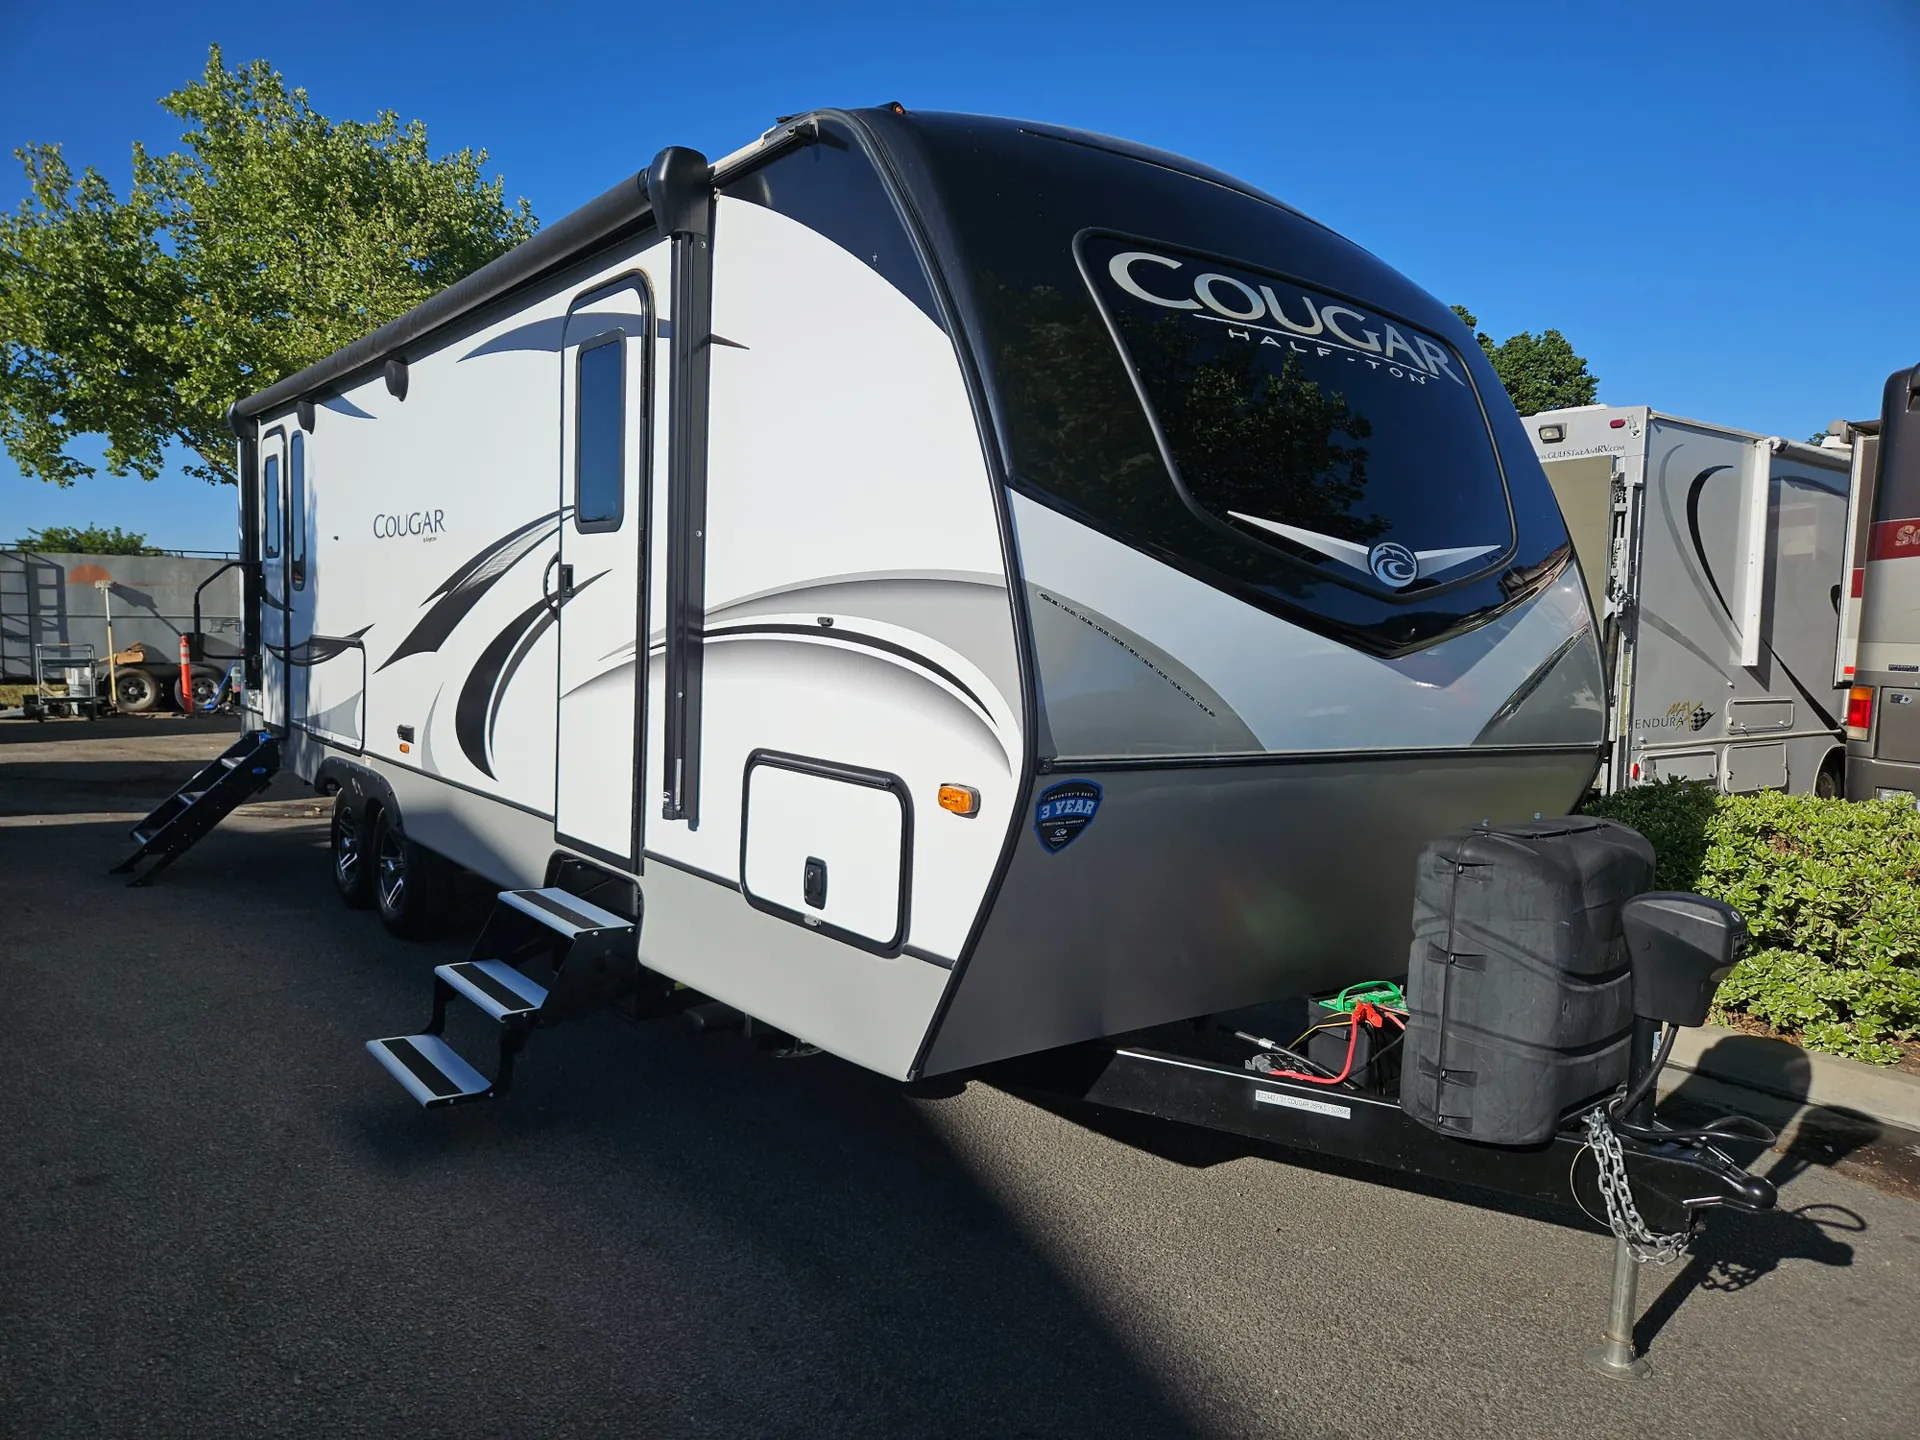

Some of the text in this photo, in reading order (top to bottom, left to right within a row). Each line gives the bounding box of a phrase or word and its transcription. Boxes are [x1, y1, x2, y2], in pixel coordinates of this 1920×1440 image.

[1108, 251, 1466, 388] COUGAR
[1227, 327, 1427, 386] HALF-TON
[373, 508, 447, 539] COUGAR
[1635, 715, 1684, 729] ENDURA
[1040, 799, 1095, 819] 3 YEAR
[1286, 1097, 1309, 1108] COUGAR
